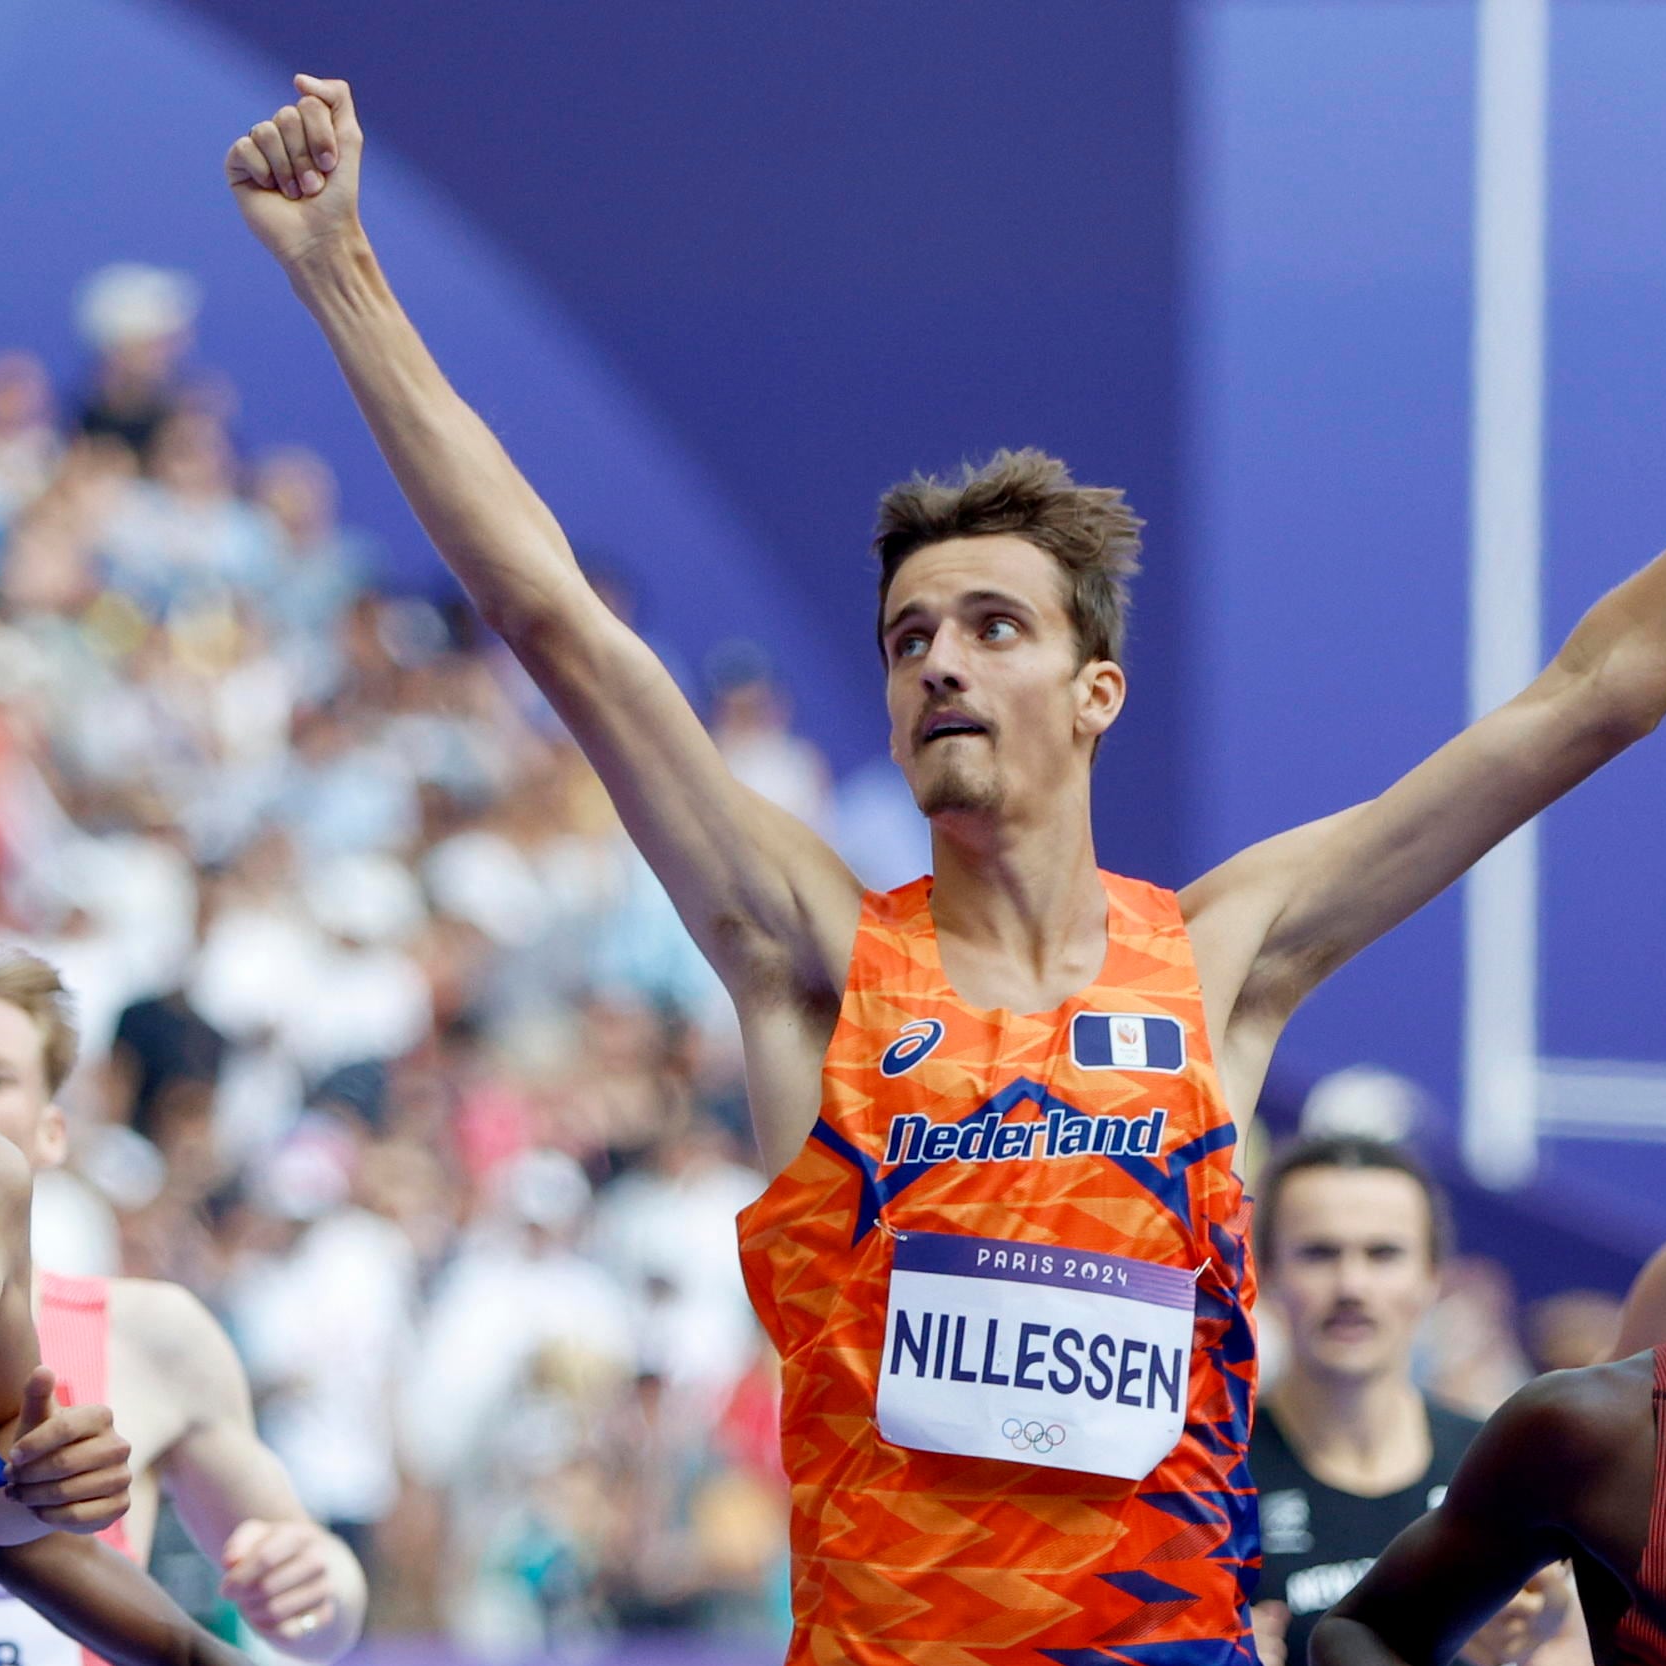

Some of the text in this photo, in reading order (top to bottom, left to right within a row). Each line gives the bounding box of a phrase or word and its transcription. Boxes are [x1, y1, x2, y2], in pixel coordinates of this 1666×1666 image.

[883, 1108, 1167, 1165] Nederland
[976, 1248, 1054, 1276] PARIS
[889, 1309, 1184, 1414] NILLESSEN
